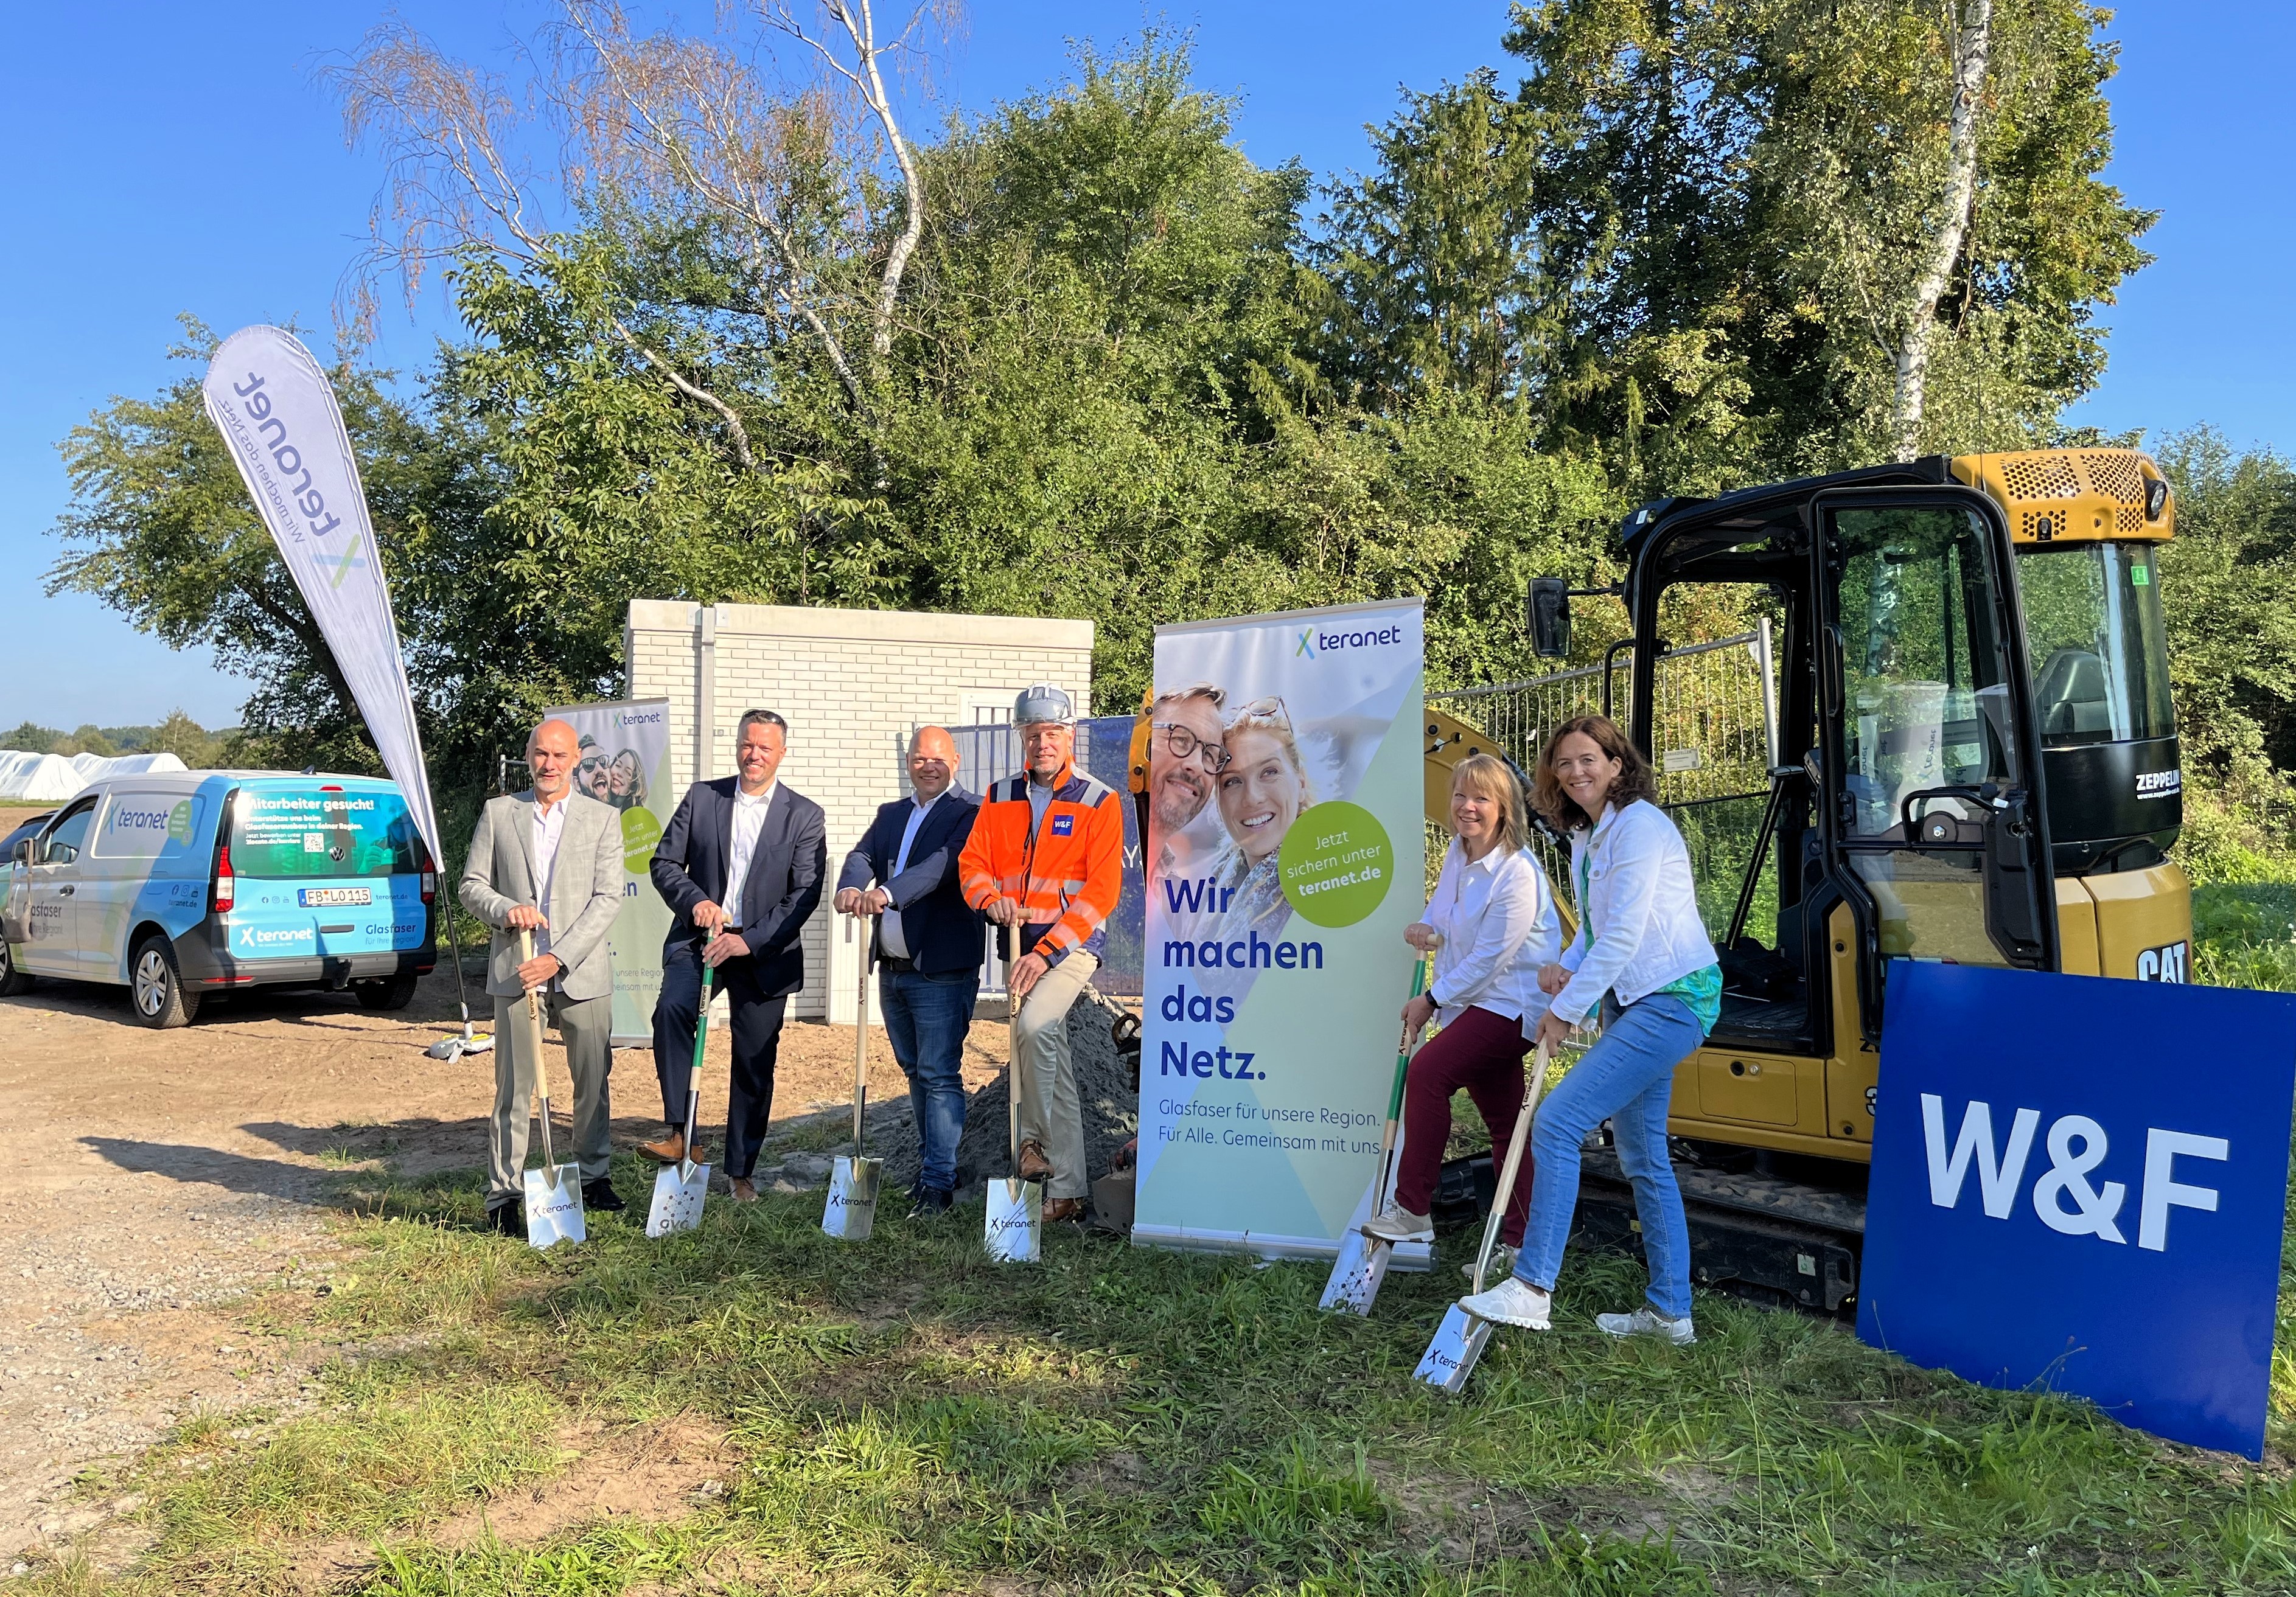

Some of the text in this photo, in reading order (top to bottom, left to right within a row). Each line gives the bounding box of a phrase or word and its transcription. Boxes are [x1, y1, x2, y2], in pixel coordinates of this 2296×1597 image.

[1319, 625, 1401, 650] teranet
[623, 712, 660, 725] teranet
[2136, 769, 2179, 791] ZEPPELIN
[323, 799, 374, 812] gesucht!
[118, 808, 168, 829] teranet
[629, 823, 644, 833] Jetzt
[623, 829, 658, 847] chern unter
[1315, 830, 1349, 850] Jetzt
[1287, 846, 1381, 878] sichern unter
[1299, 866, 1381, 896] teranet.de
[307, 891, 323, 902] FB
[348, 889, 369, 901] 115
[1164, 877, 1235, 913] Wir
[257, 928, 313, 942] teranet
[366, 924, 416, 934] Glasfaser
[1164, 931, 1323, 969] machen
[616, 969, 639, 977] unsere
[2138, 942, 2185, 984] CAT
[1161, 984, 1234, 1023] das
[1161, 1041, 1266, 1080] Netz.
[1159, 1099, 1380, 1129] Glasfaser für unsere Region.
[1159, 1126, 1181, 1142] Für
[1185, 1127, 1217, 1144] Alle.
[1223, 1130, 1316, 1150] Gemeinsam
[1322, 1136, 1345, 1152] mit
[1921, 1093, 2228, 1251] W&F
[542, 1201, 578, 1214] teranet
[841, 1197, 873, 1206] teranet
[1001, 1219, 1036, 1228] teranet
